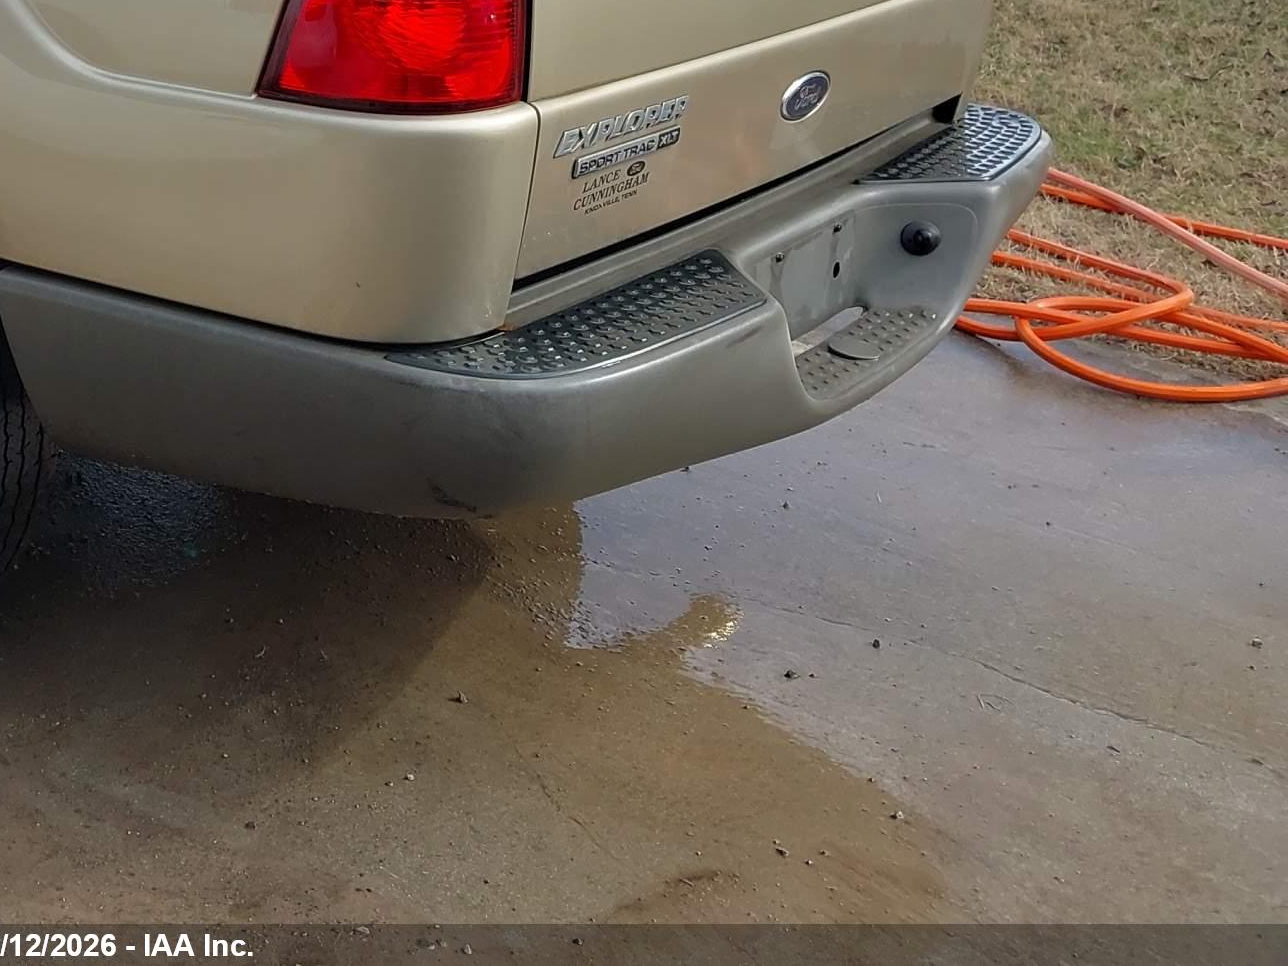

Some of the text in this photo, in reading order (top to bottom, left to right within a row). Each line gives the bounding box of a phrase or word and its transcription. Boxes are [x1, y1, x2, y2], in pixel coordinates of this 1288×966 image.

[553, 95, 689, 159] EXPLORER
[579, 150, 623, 175] SPORT
[623, 138, 656, 157] TRAC
[658, 129, 680, 148] XLT
[574, 171, 650, 211] CUNNINGHAM
[582, 169, 622, 195] LANCE
